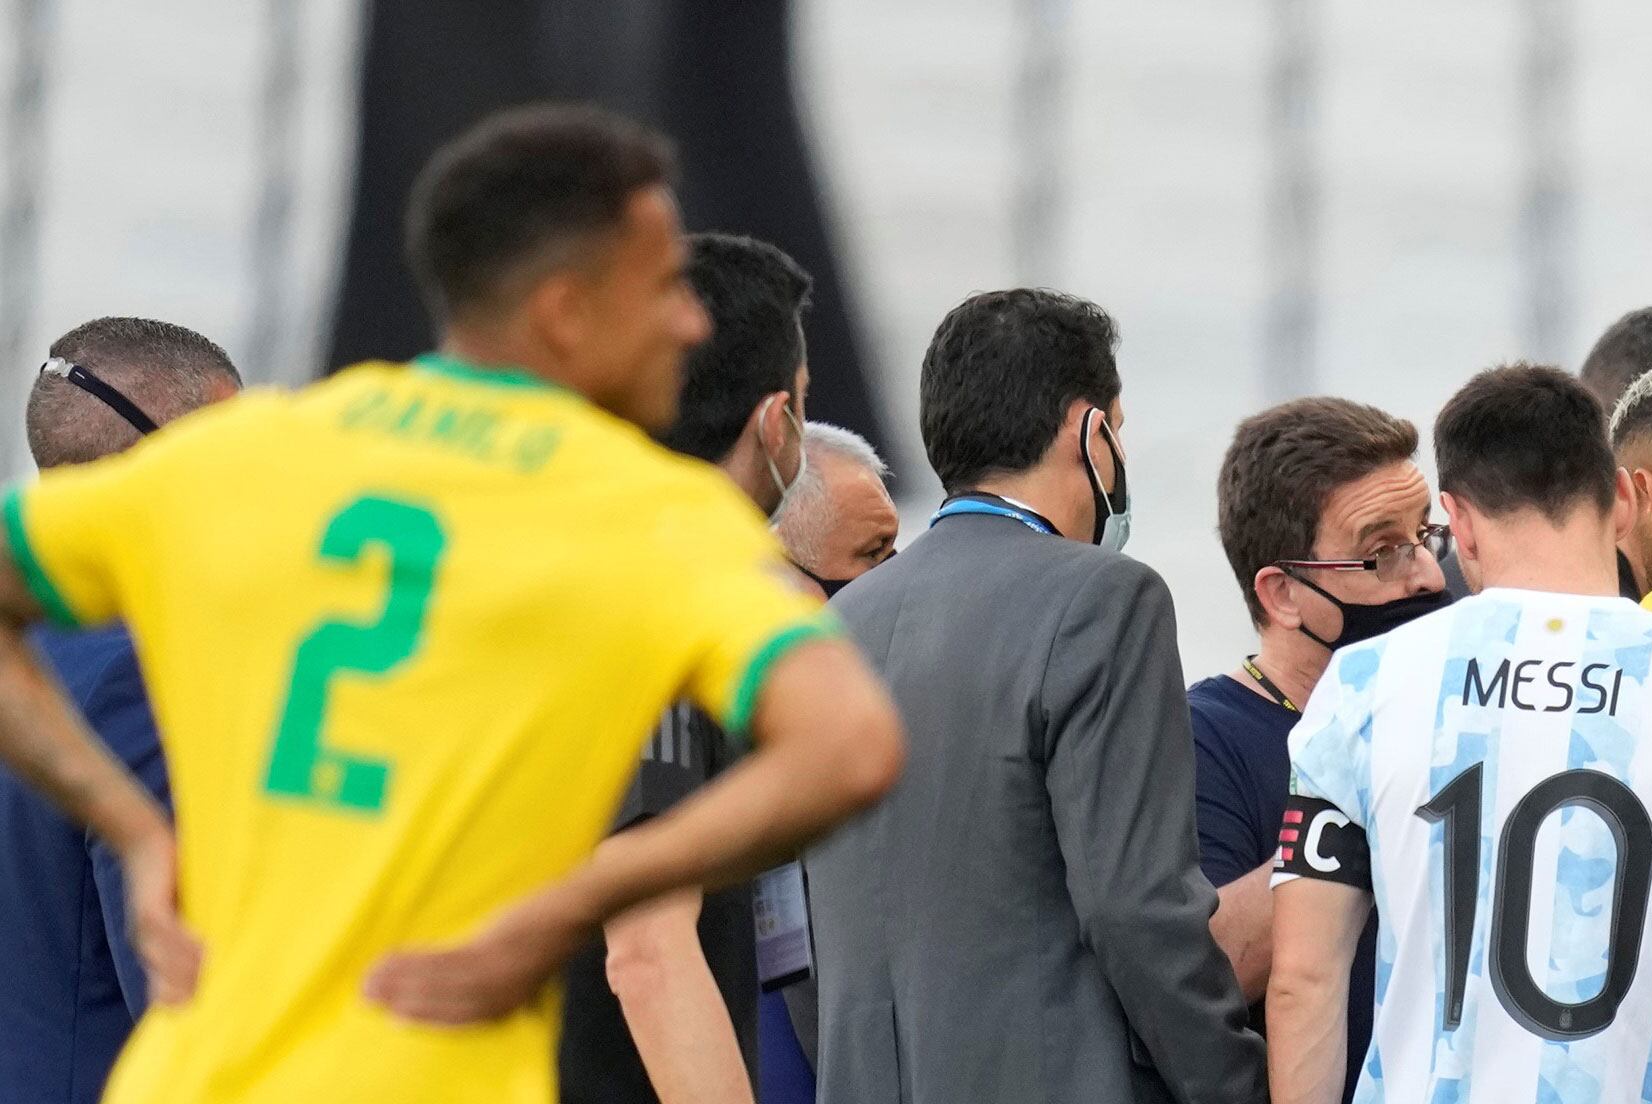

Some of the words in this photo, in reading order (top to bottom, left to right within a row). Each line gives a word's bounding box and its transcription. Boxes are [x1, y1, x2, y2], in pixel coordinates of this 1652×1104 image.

[267, 496, 446, 809] 2
[1462, 658, 1623, 717] MESSI
[1304, 809, 1350, 872] C
